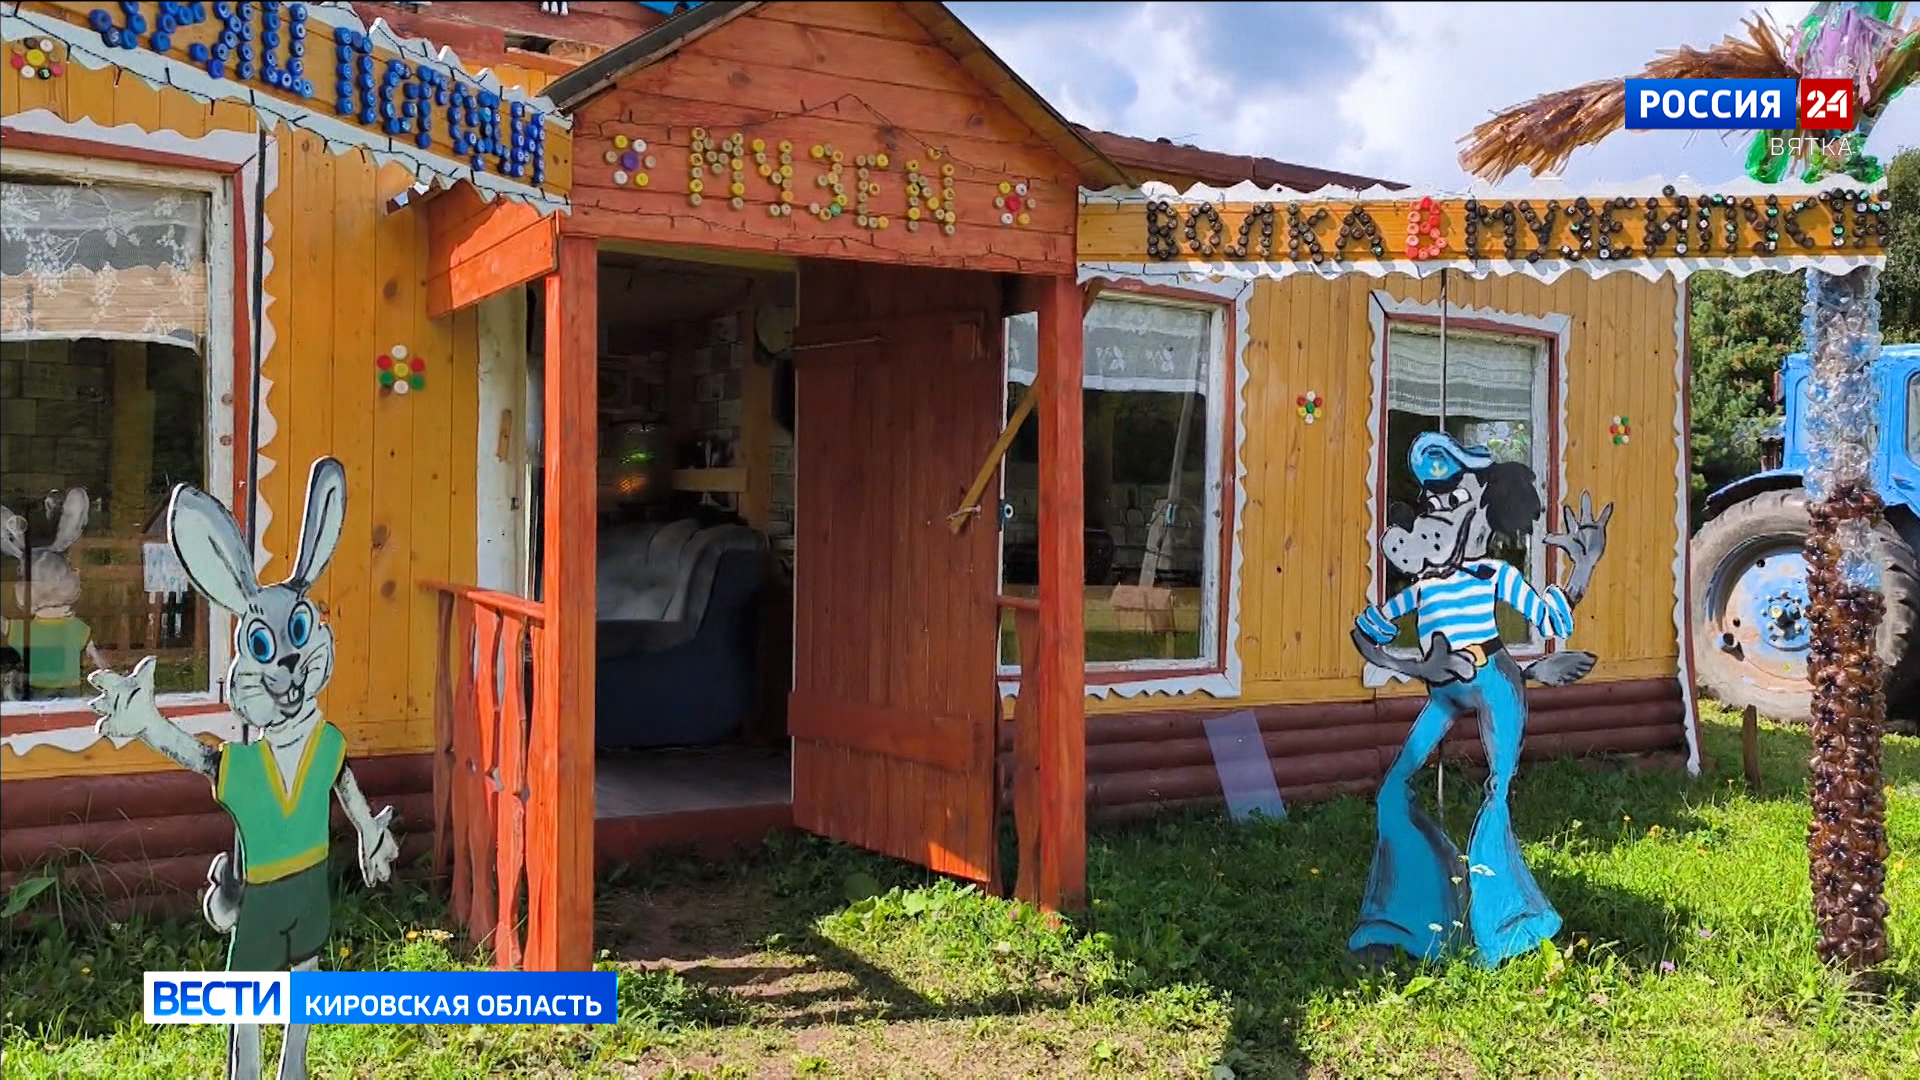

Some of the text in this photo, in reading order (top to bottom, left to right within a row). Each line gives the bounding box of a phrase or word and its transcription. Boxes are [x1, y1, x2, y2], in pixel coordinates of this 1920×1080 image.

[689, 126, 957, 236] МУЗЕЙ
[1146, 200, 1385, 264] ВОЛКА
[1405, 195, 1448, 259] В
